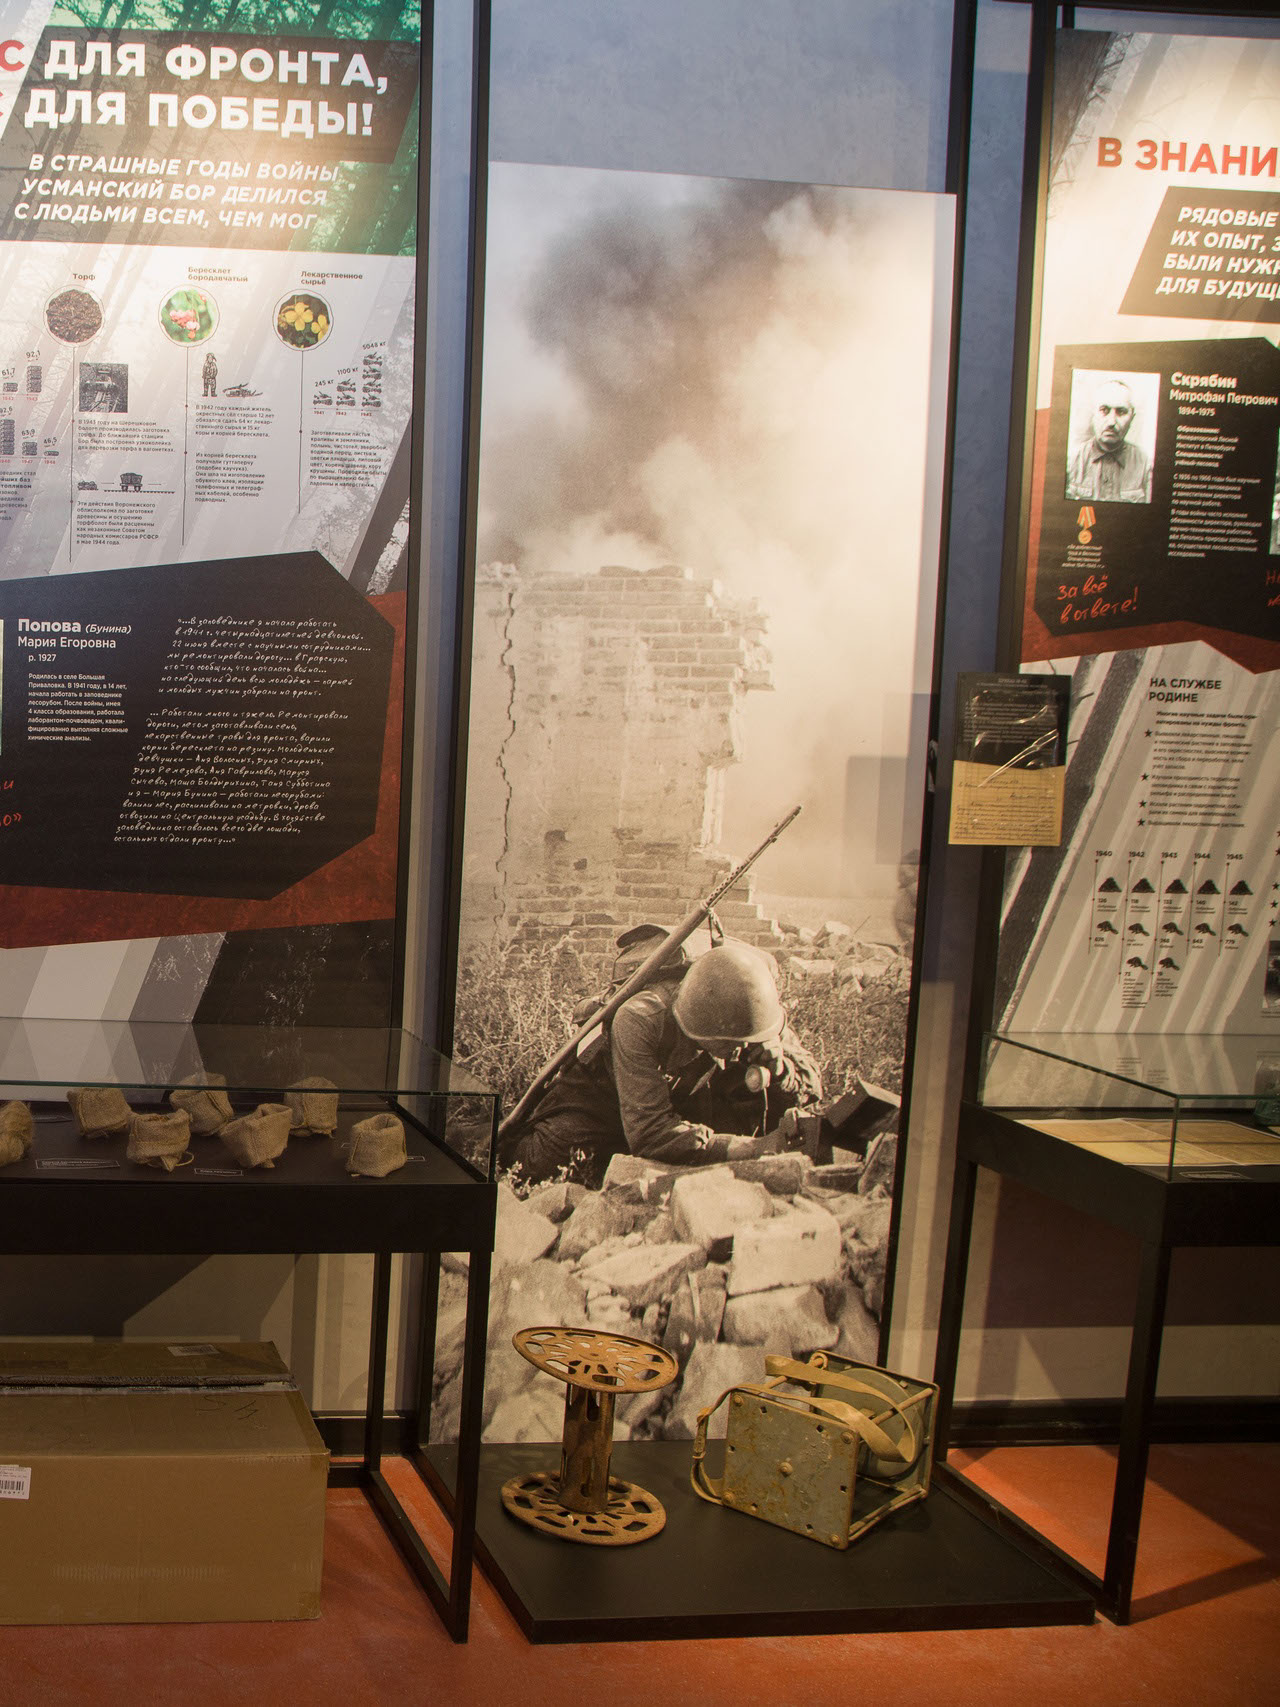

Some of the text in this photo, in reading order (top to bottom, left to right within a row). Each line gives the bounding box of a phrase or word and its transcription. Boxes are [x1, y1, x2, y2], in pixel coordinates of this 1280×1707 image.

[43, 40, 146, 81] ДЛЯ
[165, 43, 389, 95] ФРОНТА,
[23, 89, 126, 129] ДЛЯ
[147, 92, 375, 139] ПОБЕДЫ!
[1097, 137, 1280, 178] В ЗНАНИ
[28, 154, 340, 183] В СТРАШНЫЕ ГОДЫ ВОЙНЫ
[20, 178, 328, 207] УСМАНСКИЙ БОР ДЕЛИЛСЯ
[13, 203, 318, 230] С ЛЮДЬМИ ВСЕМ, ЧЕМ МОГ
[1178, 206, 1280, 228] РЯДОВЫЕ
[1170, 229, 1201, 247] ИХ
[1203, 231, 1266, 254] ОПЫТ,
[72, 273, 96, 281] Торф
[187, 274, 249, 283] бородавчатый
[188, 266, 231, 275] Бересклет
[301, 271, 363, 280] Лекарственное
[300, 278, 326, 286] сырьё
[1203, 279, 1280, 302] БУДУЩ
[25, 350, 41, 359] 92,1
[1, 367, 16, 376] 61,7
[1170, 371, 1238, 389] Скрябин
[1169, 388, 1279, 406] Митрофан Петрович
[1178, 406, 1216, 417] 1894-1975
[1060, 586, 1139, 624] в ответе!
[19, 619, 131, 634] Попова (Бунина)
[18, 636, 116, 649] Мария Егоровна
[1150, 678, 1221, 689] НА СЛУЖБЕ
[1149, 692, 1198, 703] РОДИНЕ
